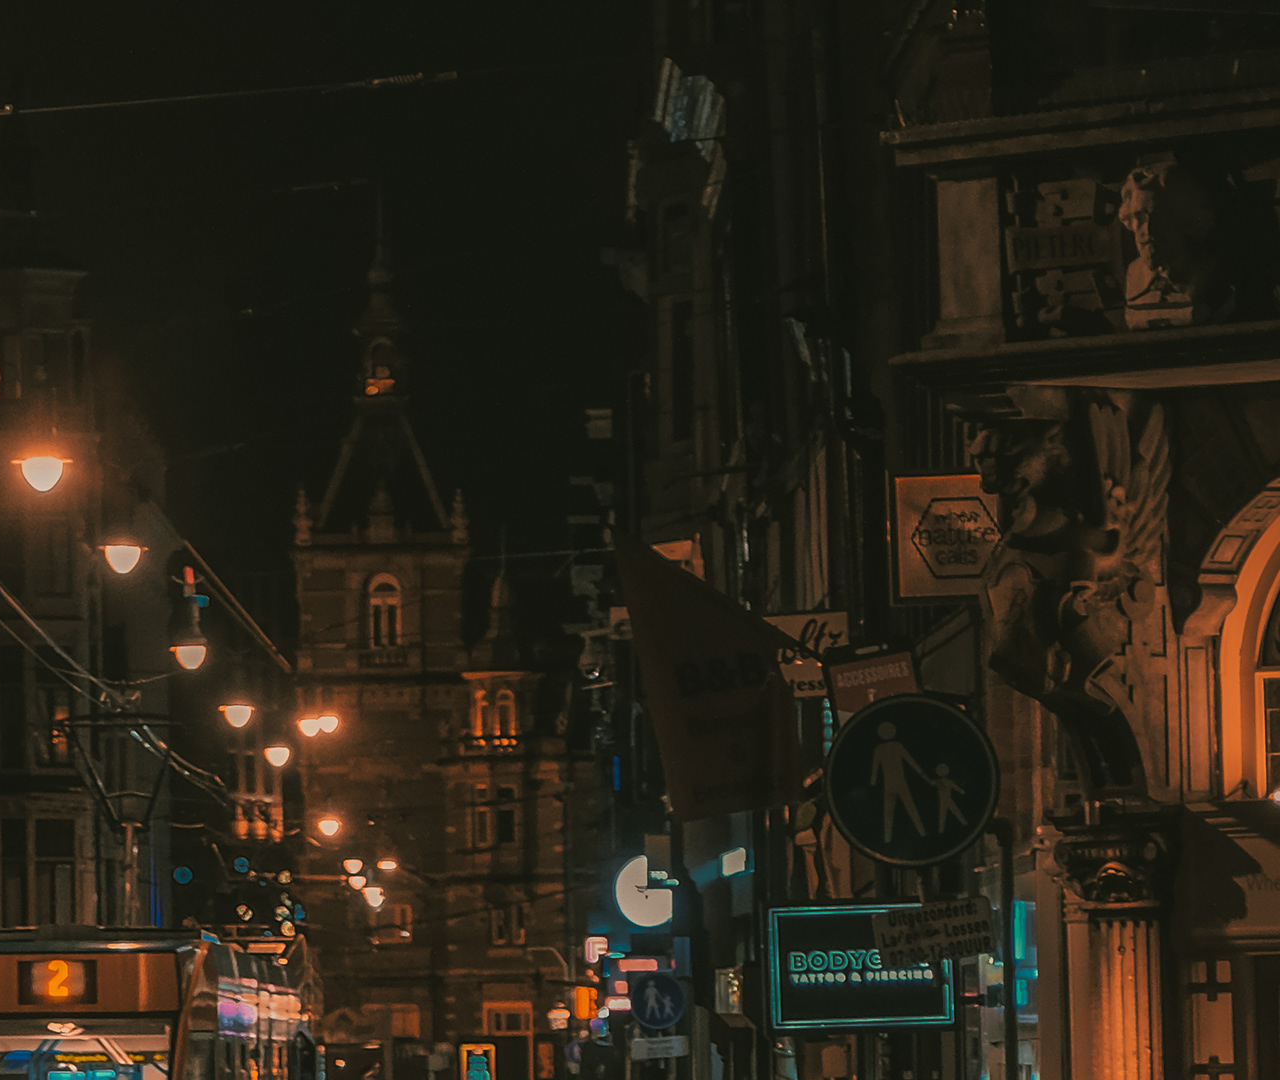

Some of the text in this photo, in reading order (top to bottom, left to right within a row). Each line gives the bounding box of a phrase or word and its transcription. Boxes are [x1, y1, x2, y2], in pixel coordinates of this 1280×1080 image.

[918, 525, 996, 547] nature
[47, 959, 69, 998] 2
[791, 972, 847, 984] TATTOO
[865, 968, 934, 983] PIERCING
